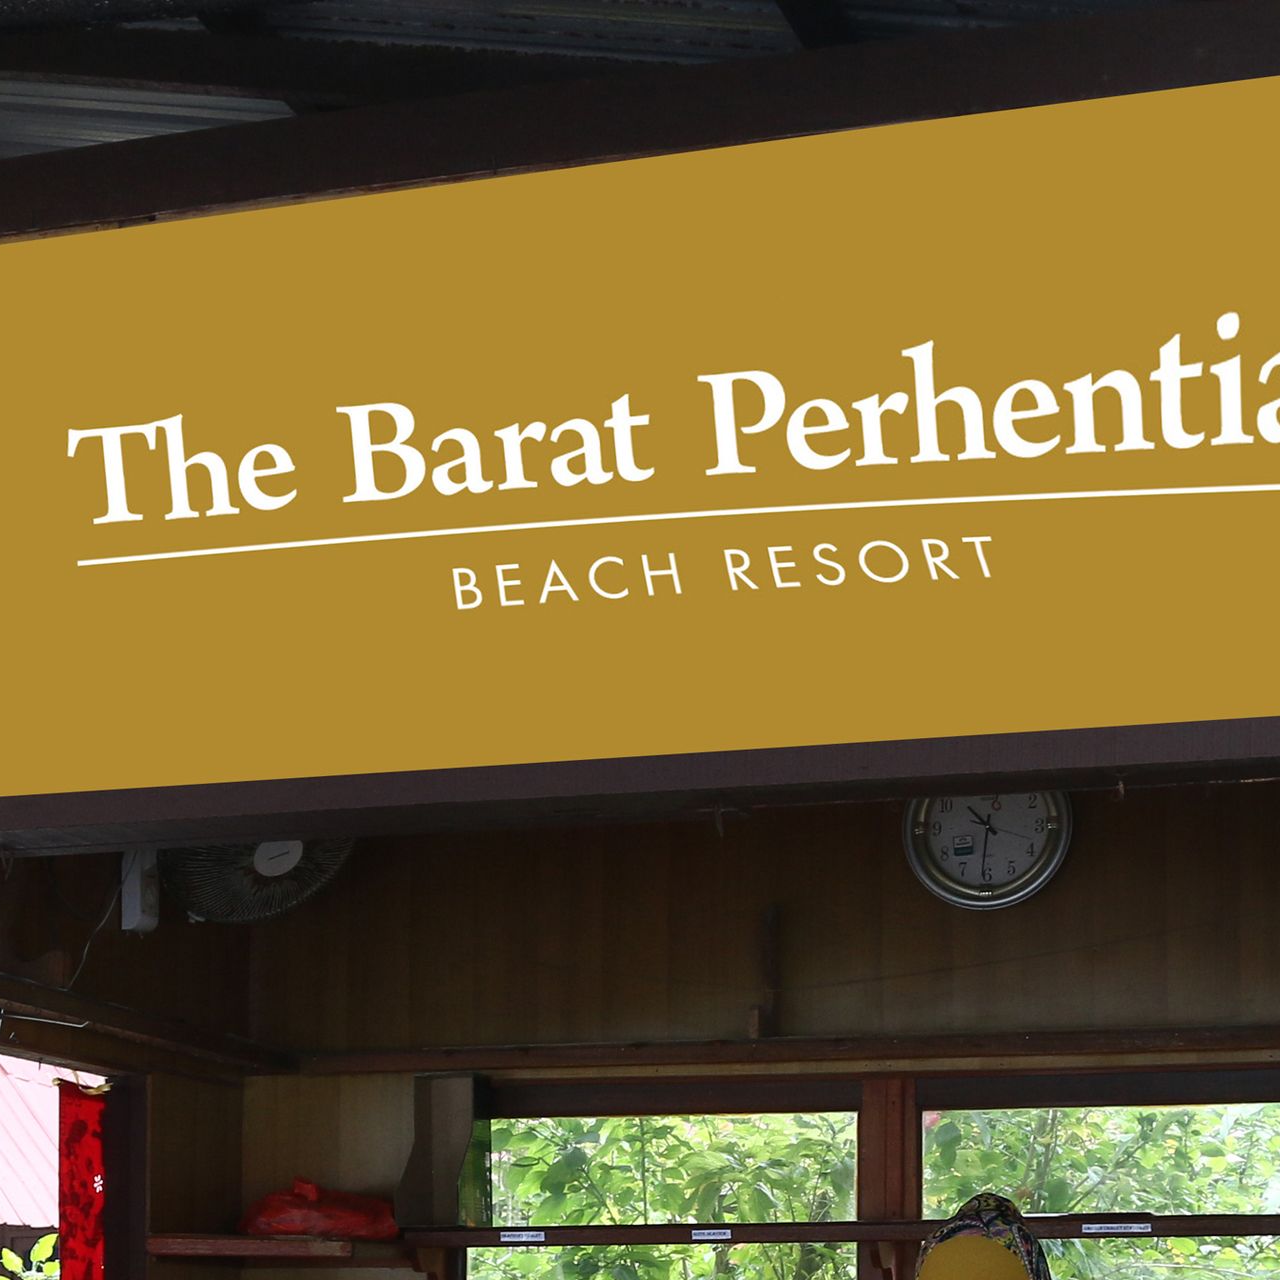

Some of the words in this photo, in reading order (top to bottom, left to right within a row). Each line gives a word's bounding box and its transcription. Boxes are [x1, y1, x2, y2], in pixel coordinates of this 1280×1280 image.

[67, 415, 297, 524] The
[337, 394, 655, 503] Barat
[453, 553, 682, 610] BEACH
[724, 536, 997, 590] RESORT
[940, 799, 953, 813] 10
[1028, 794, 1038, 809] 2
[932, 822, 942, 837] 9
[1034, 819, 1044, 833] 3
[940, 846, 950, 861] 8
[1025, 843, 1036, 857] 4
[958, 862, 967, 877] 7
[982, 868, 992, 882] 6
[1007, 860, 1016, 875] 5
